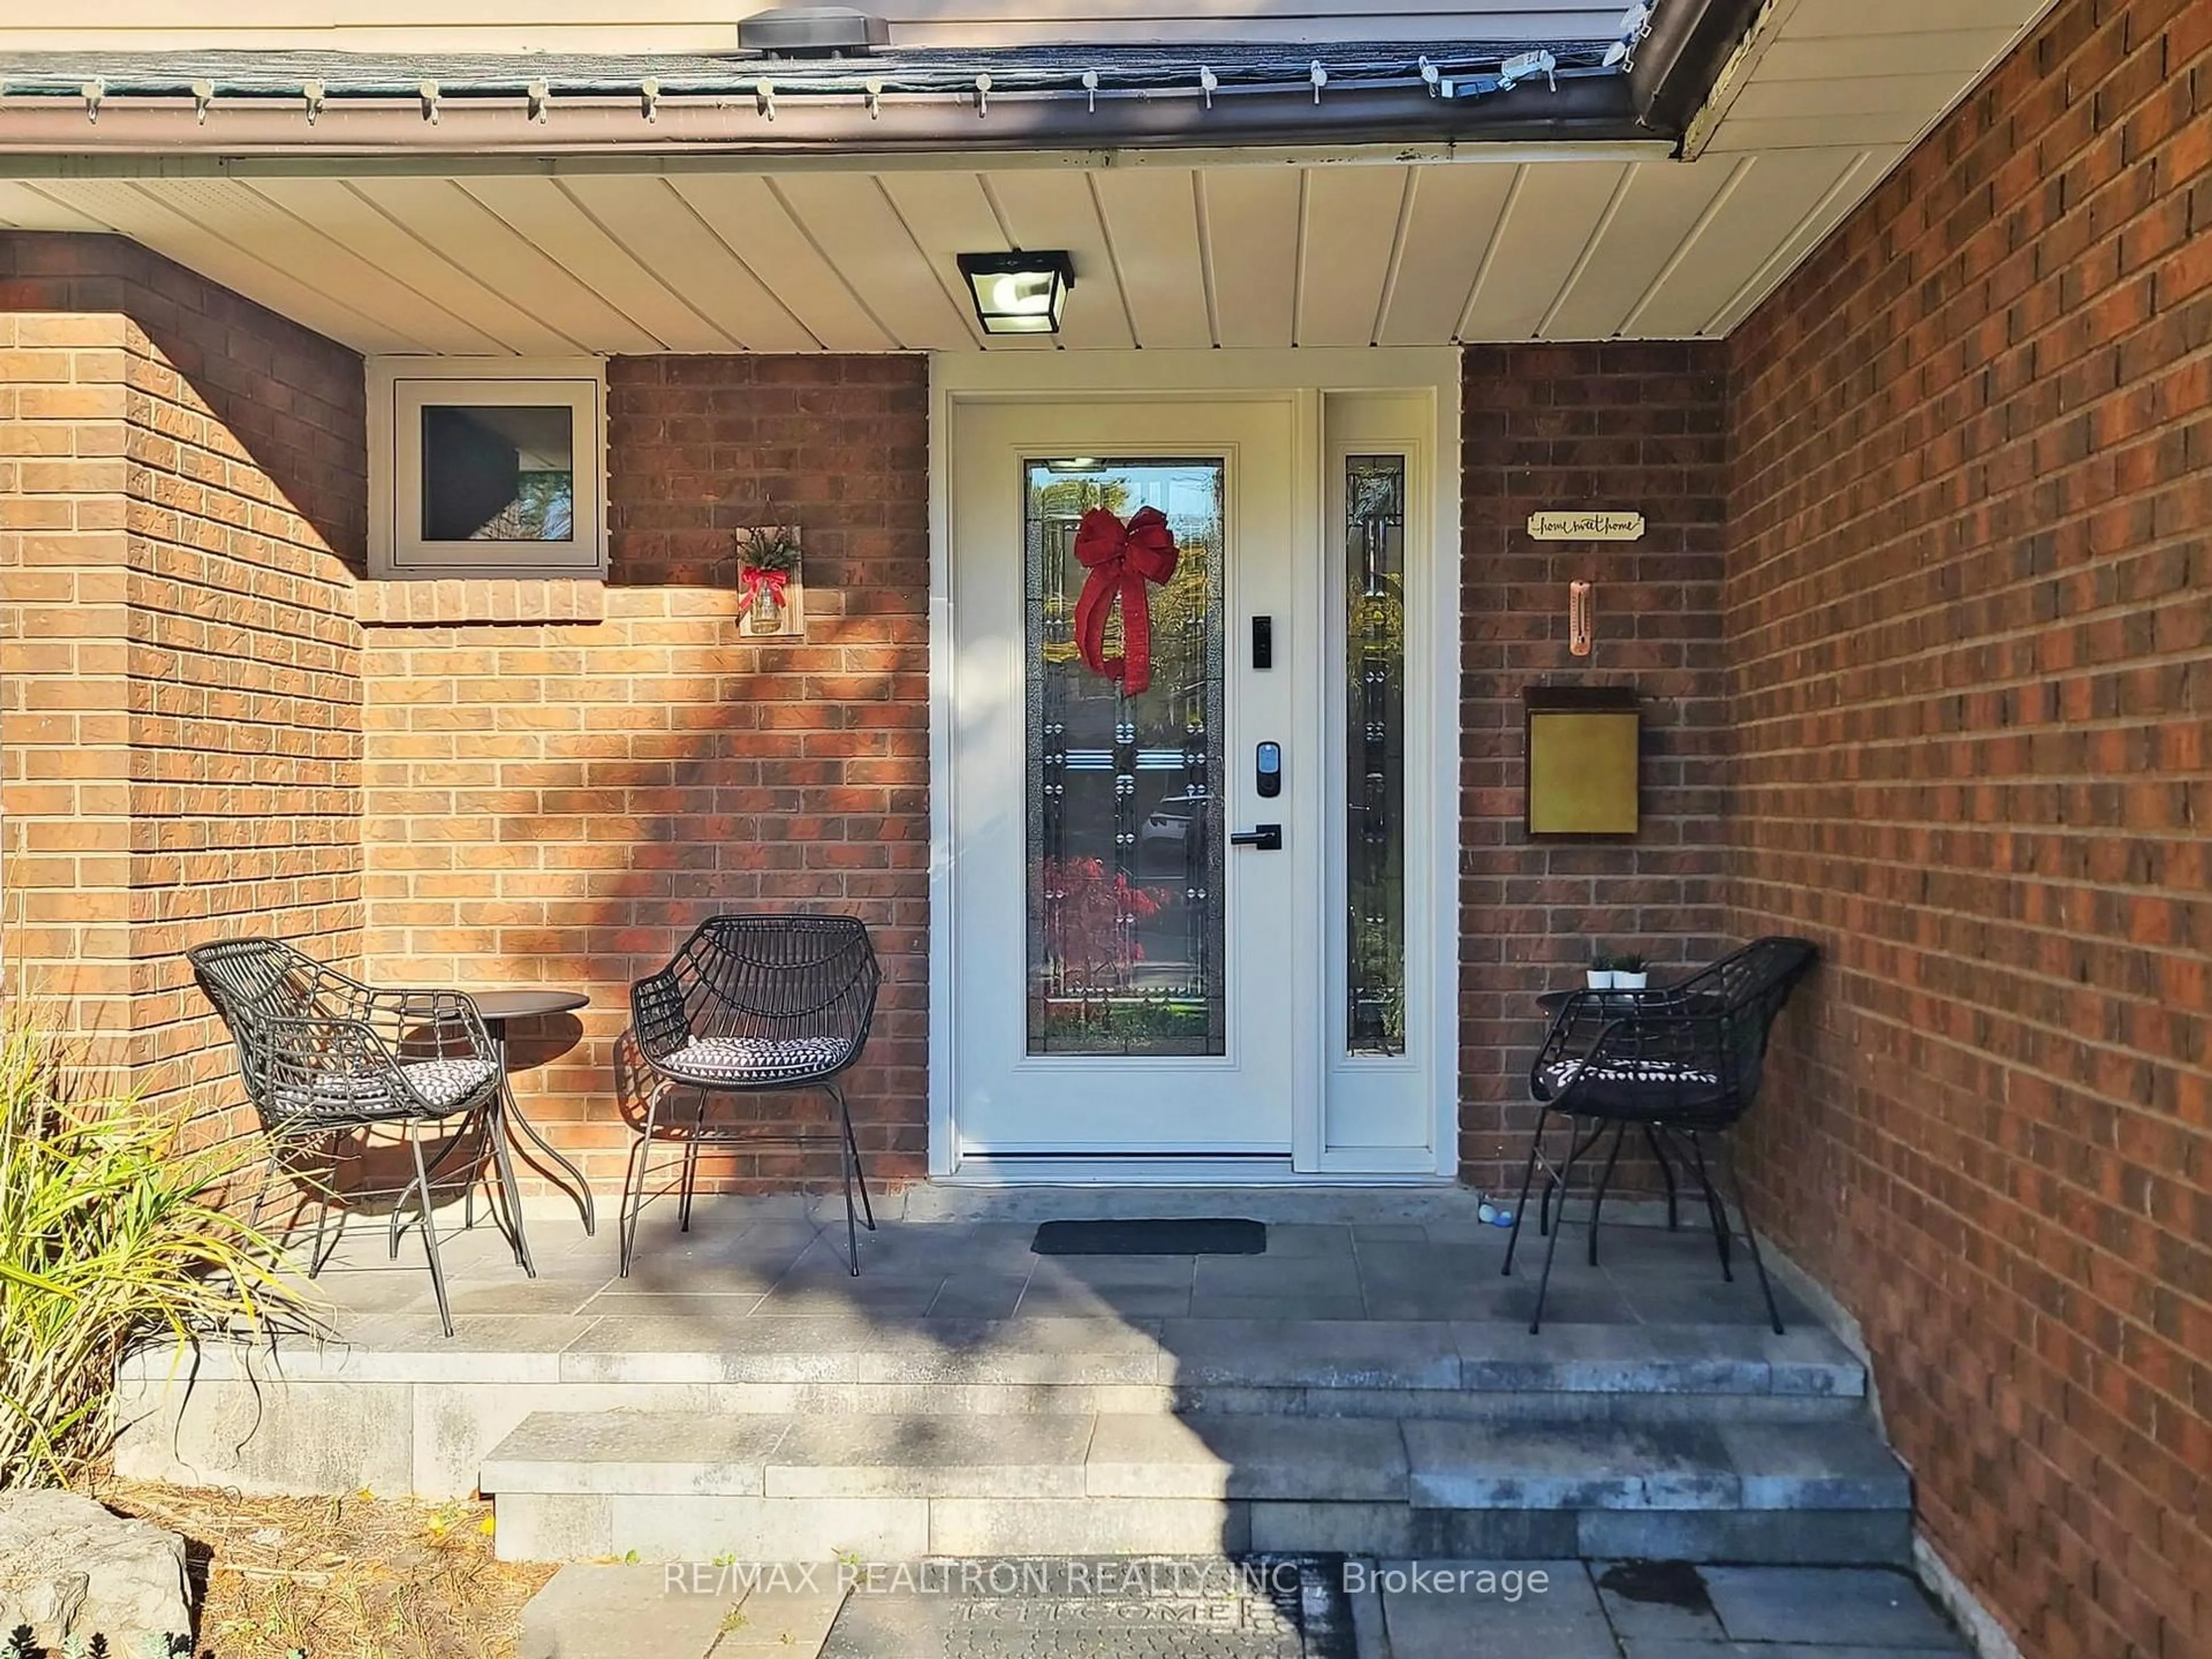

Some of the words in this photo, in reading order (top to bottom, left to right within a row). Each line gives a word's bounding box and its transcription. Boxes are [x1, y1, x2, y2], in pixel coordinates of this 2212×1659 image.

[1537, 517, 1572, 535] home
[1573, 514, 1603, 533] sweet
[1604, 517, 1641, 535] home
